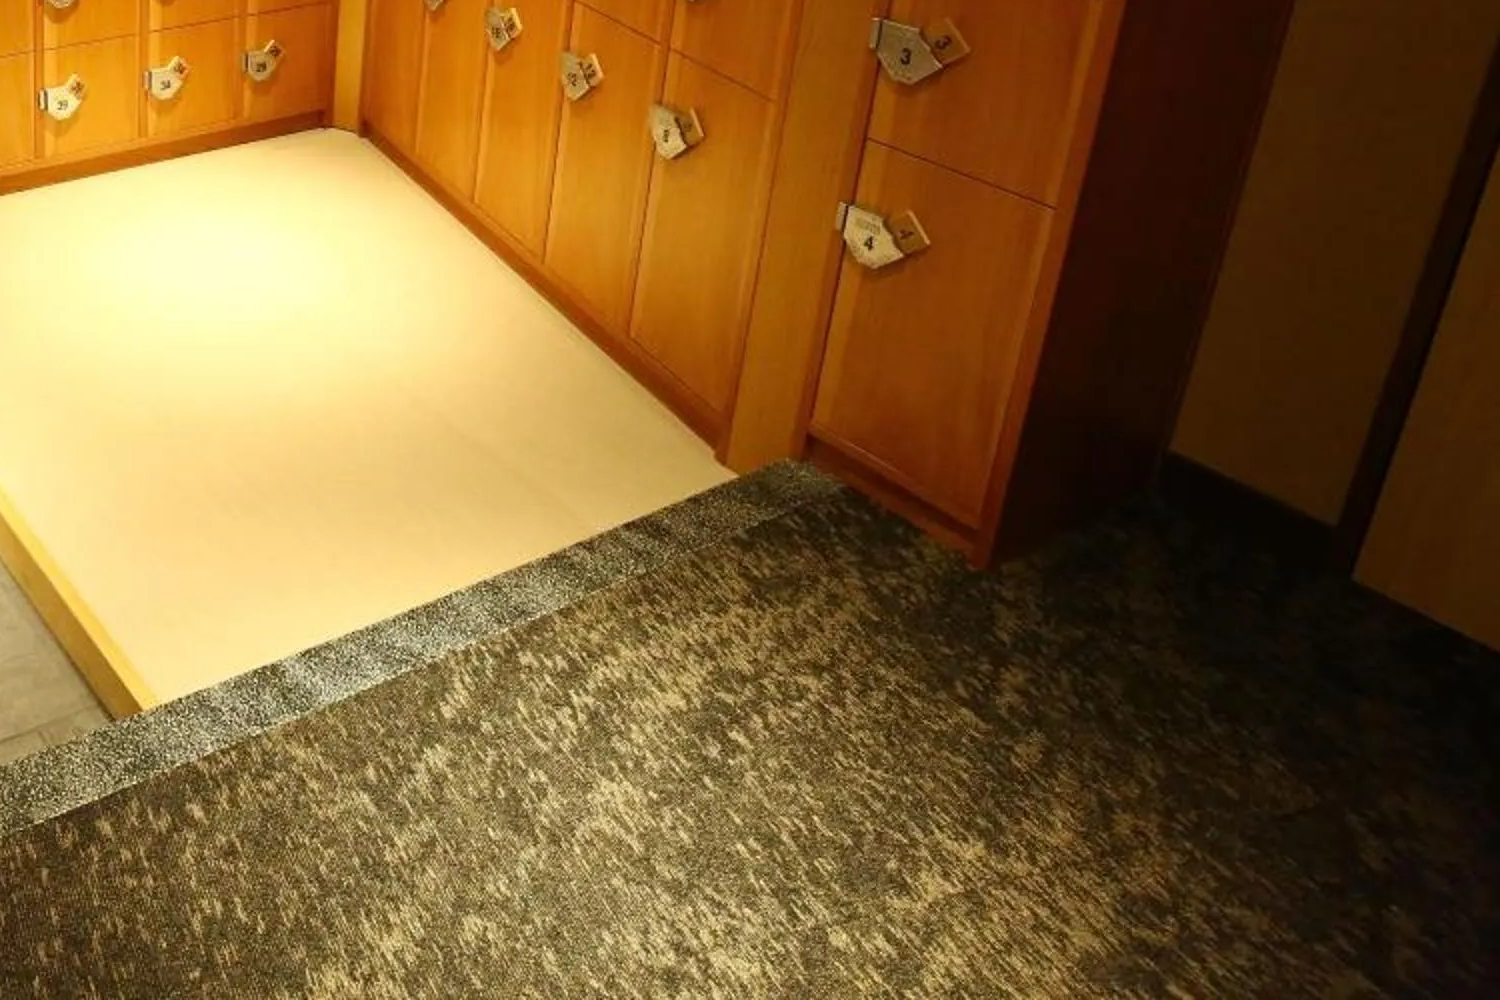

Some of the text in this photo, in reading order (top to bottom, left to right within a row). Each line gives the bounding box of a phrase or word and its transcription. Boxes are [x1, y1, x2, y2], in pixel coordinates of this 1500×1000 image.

[934, 35, 952, 50] 3
[900, 47, 912, 65] 3
[864, 235, 874, 251] 4
